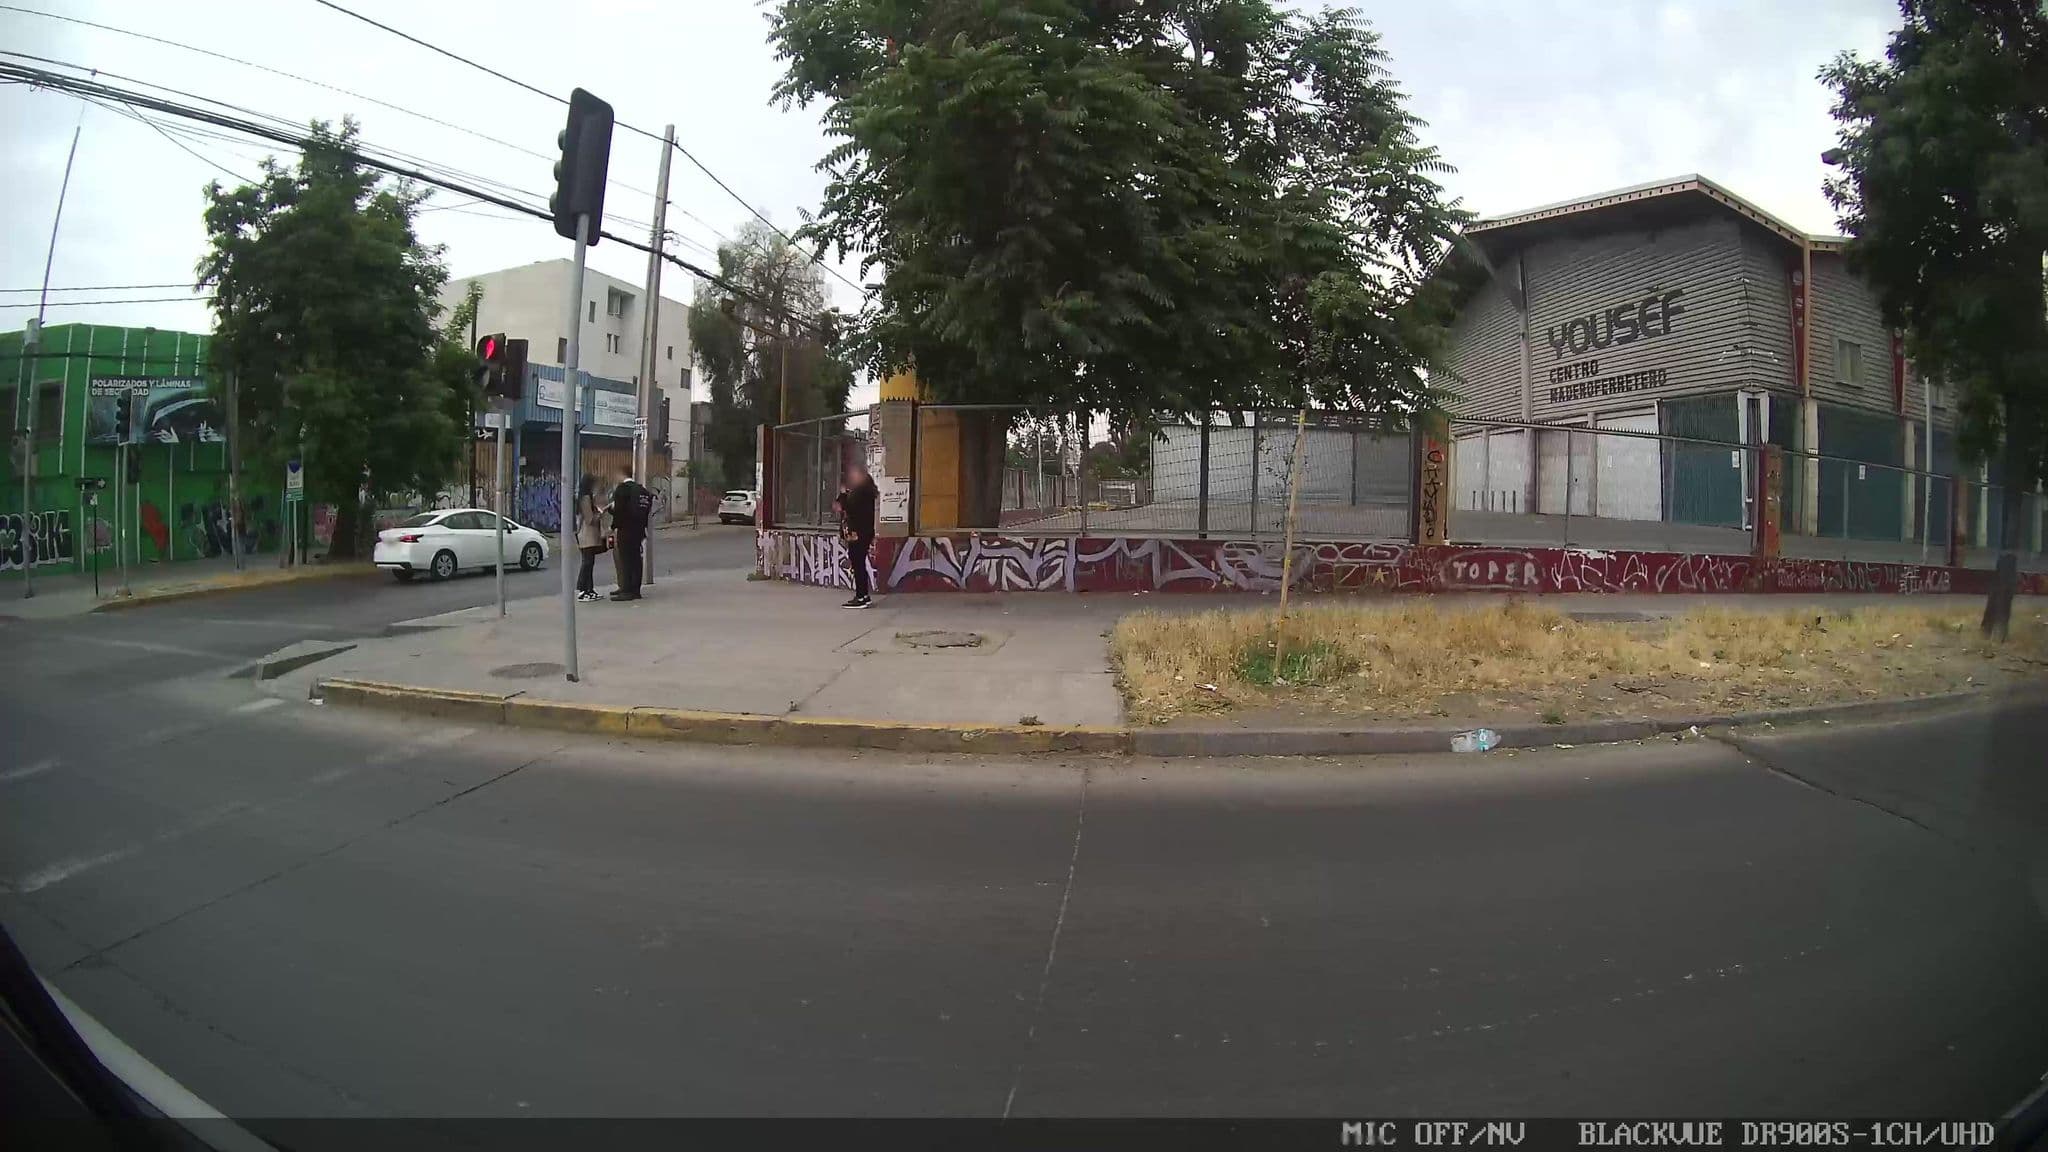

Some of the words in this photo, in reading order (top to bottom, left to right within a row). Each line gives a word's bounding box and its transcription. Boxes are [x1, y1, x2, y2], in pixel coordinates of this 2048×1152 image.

[1550, 359, 1600, 385] CENTRO
[92, 379, 147, 388] POLARIZADOS
[149, 379, 155, 388] Y
[156, 377, 191, 388] LÁMINAS
[91, 388, 103, 396] DE
[1452, 560, 1539, 585] TOPER
